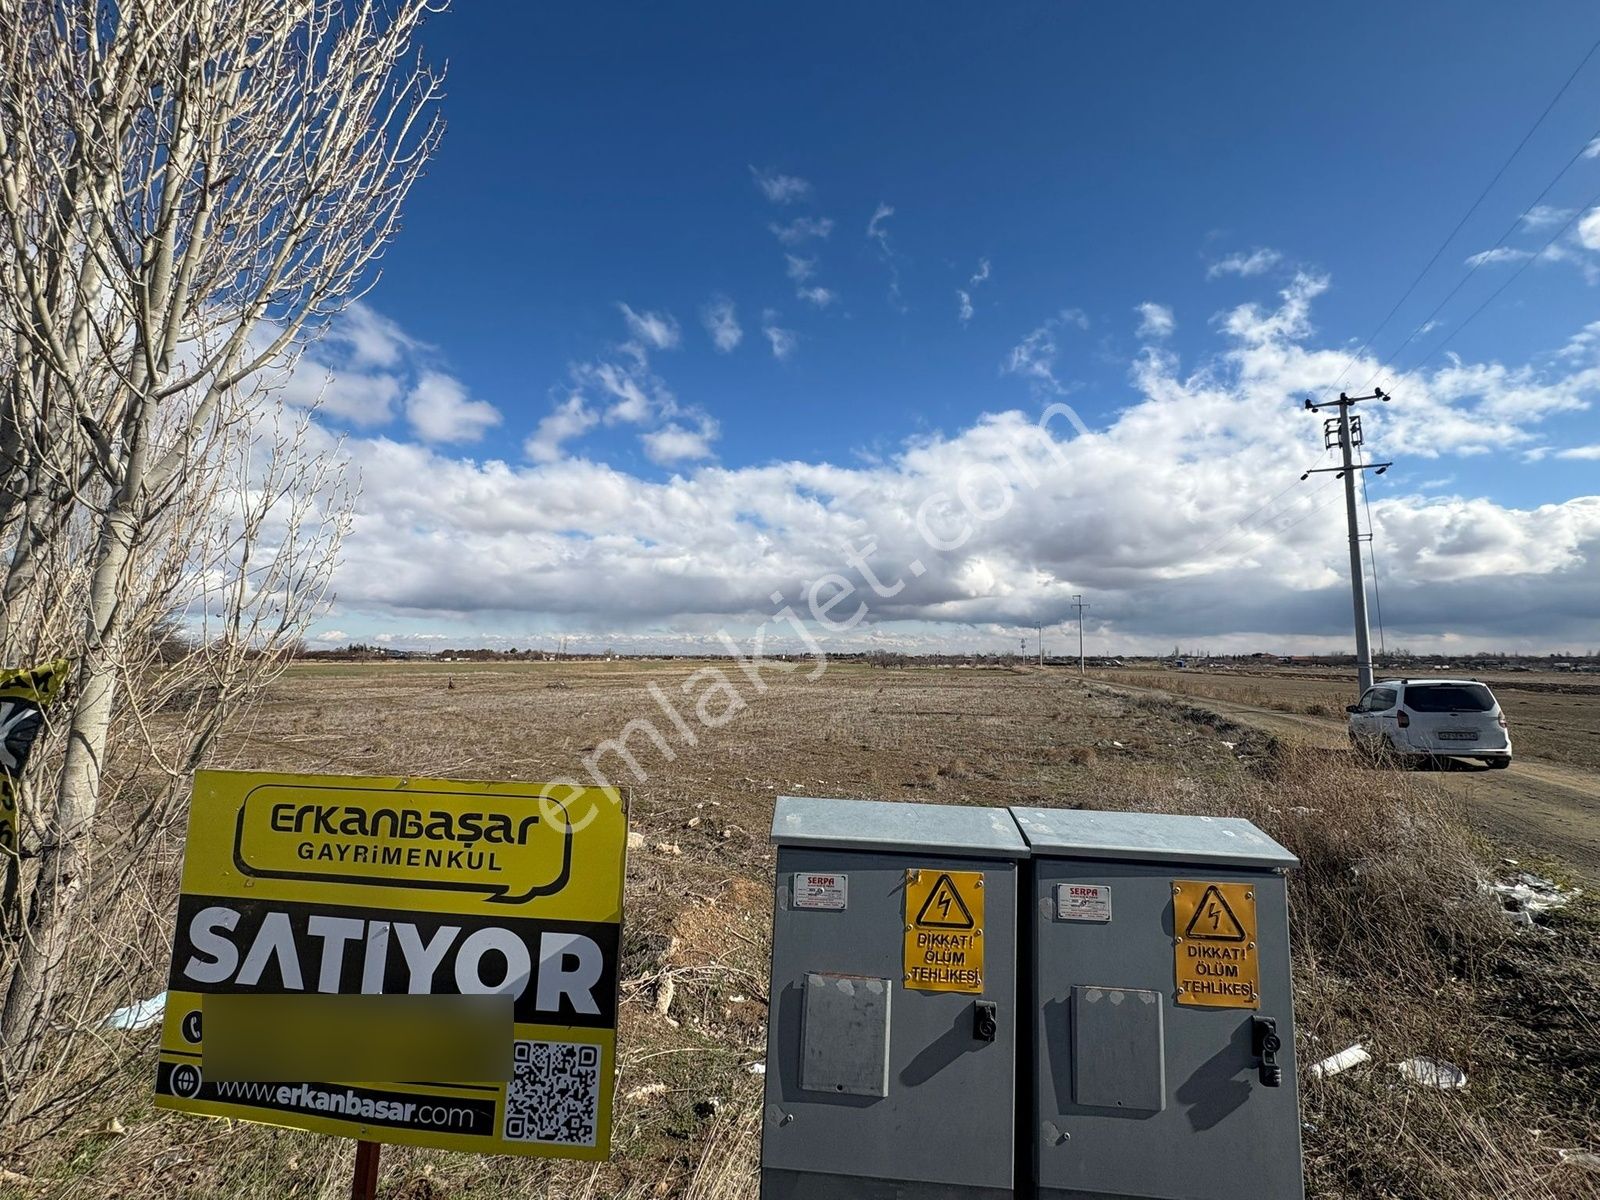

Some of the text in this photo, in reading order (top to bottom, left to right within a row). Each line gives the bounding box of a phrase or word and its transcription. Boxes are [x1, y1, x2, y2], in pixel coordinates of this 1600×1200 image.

[807, 876, 835, 886] SERPA
[1070, 887, 1098, 896] SERPA
[183, 906, 601, 1015] SATIYOR
[924, 946, 965, 966] ÖLÜM
[912, 965, 979, 983] TEHLİKESİ
[1196, 960, 1238, 977] ÖLÜM
[1182, 979, 1253, 996] TEHLİKESİ
[216, 1082, 475, 1128] www.erkanbasar.com
